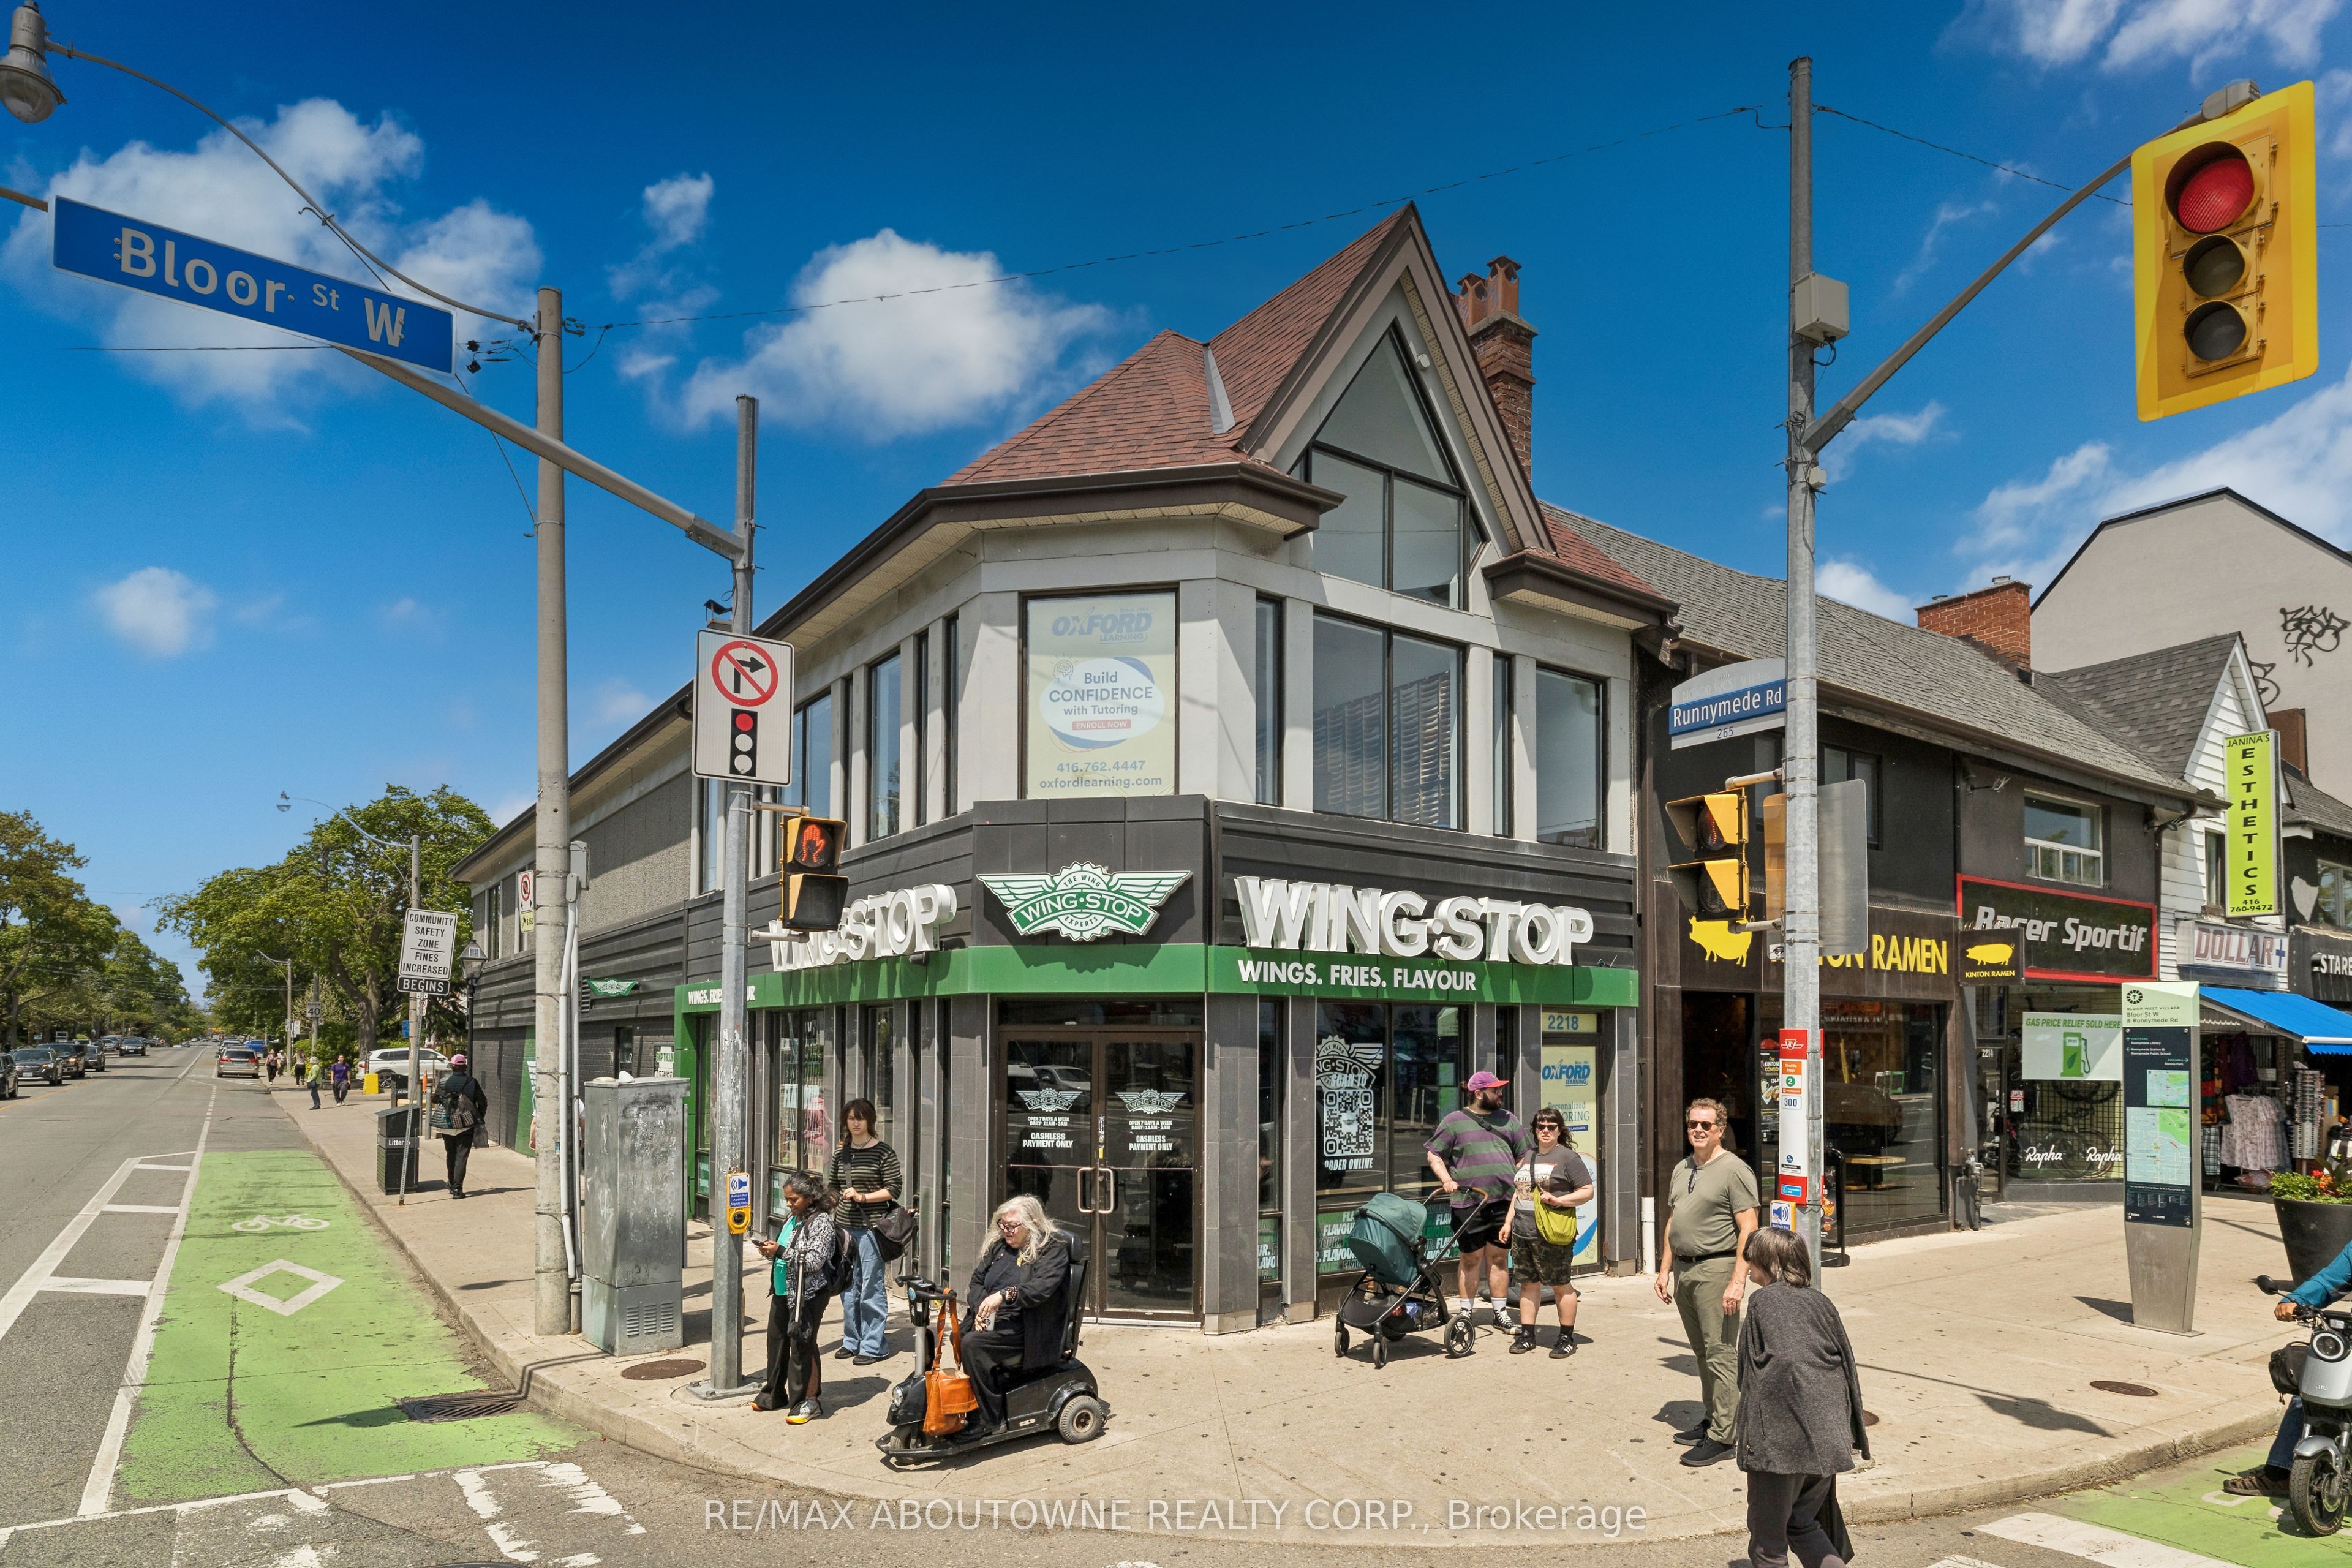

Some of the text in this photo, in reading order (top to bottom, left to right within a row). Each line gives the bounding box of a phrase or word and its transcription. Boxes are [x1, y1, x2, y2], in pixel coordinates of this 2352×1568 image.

[121, 228, 405, 348] Bloor St W
[1052, 607, 1152, 636] OXFORD
[1100, 633, 1144, 641] LEARNING
[1084, 672, 1118, 684] Build
[1049, 687, 1153, 703] CONFIDENCE
[1063, 704, 1137, 717] with Tutoring
[1673, 687, 1782, 727] Runnymede Rd
[1717, 726, 1733, 739] 265
[2226, 733, 2270, 748] JANINA'S
[1057, 761, 1145, 772] 416.762.4447
[1039, 775, 1162, 788] oxfordlearning.com
[2240, 748, 2258, 895] ESTHETICS
[1063, 875, 1101, 887] THE WING
[2230, 903, 2273, 912] 760-9472
[409, 913, 453, 926] COMMUNITY
[1065, 916, 1098, 927] EXPERTS
[415, 926, 445, 937] SAFETY
[1975, 906, 2147, 952] Racer Sportif
[418, 939, 439, 949] ZONE
[415, 952, 439, 962] FINES
[1872, 934, 1947, 974] RAMEN
[403, 963, 448, 975] INCREASED
[1238, 960, 1476, 990] WINGS. FRIES. FLAVOUR
[403, 980, 443, 992] BEGINS
[1548, 1015, 1578, 1030] 2218
[2026, 1018, 2040, 1027] GAS
[2041, 1019, 2061, 1027] PRICE
[2063, 1019, 2084, 1028] RELIEF
[1333, 1044, 1345, 1054] WING
[1982, 1049, 1994, 1057] 2214
[1542, 1060, 1591, 1080] OXFORD
[1330, 1074, 1354, 1087] SCAN
[1357, 1074, 1367, 1087] TO
[1784, 1098, 1797, 1107] 300
[1564, 1110, 1589, 1121] ORING
[2024, 1144, 2063, 1169] Rapha
[2086, 1145, 2122, 1169] Rapha
[1324, 1158, 1373, 1170] ORDER ONLINE
